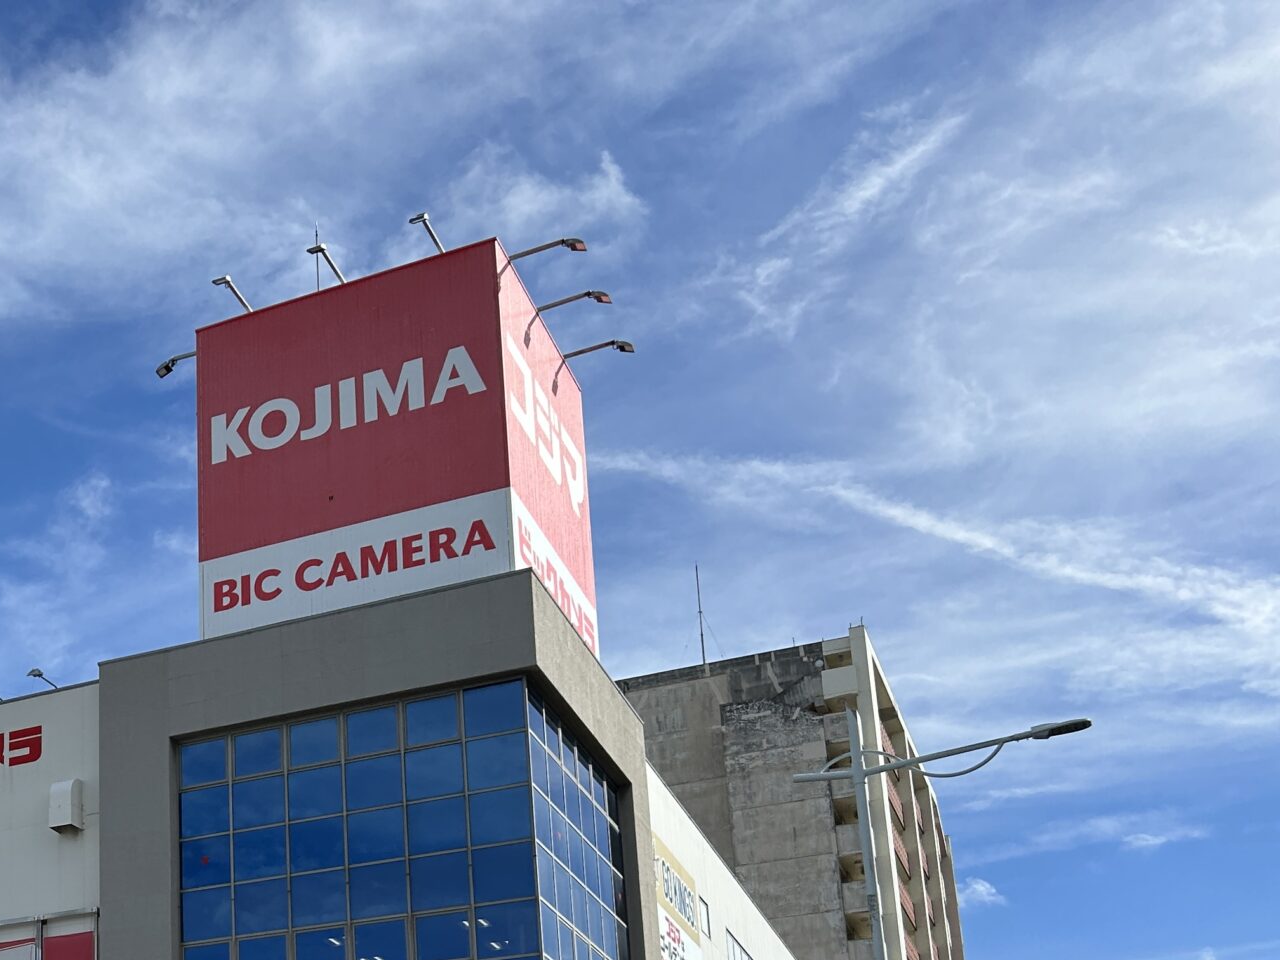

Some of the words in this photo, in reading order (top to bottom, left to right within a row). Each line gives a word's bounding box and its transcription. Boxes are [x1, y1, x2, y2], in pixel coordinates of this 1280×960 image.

[210, 345, 487, 465] KOJIMA
[506, 331, 585, 519] コジマ
[213, 568, 282, 613] BIC
[295, 519, 496, 592] CAMERA
